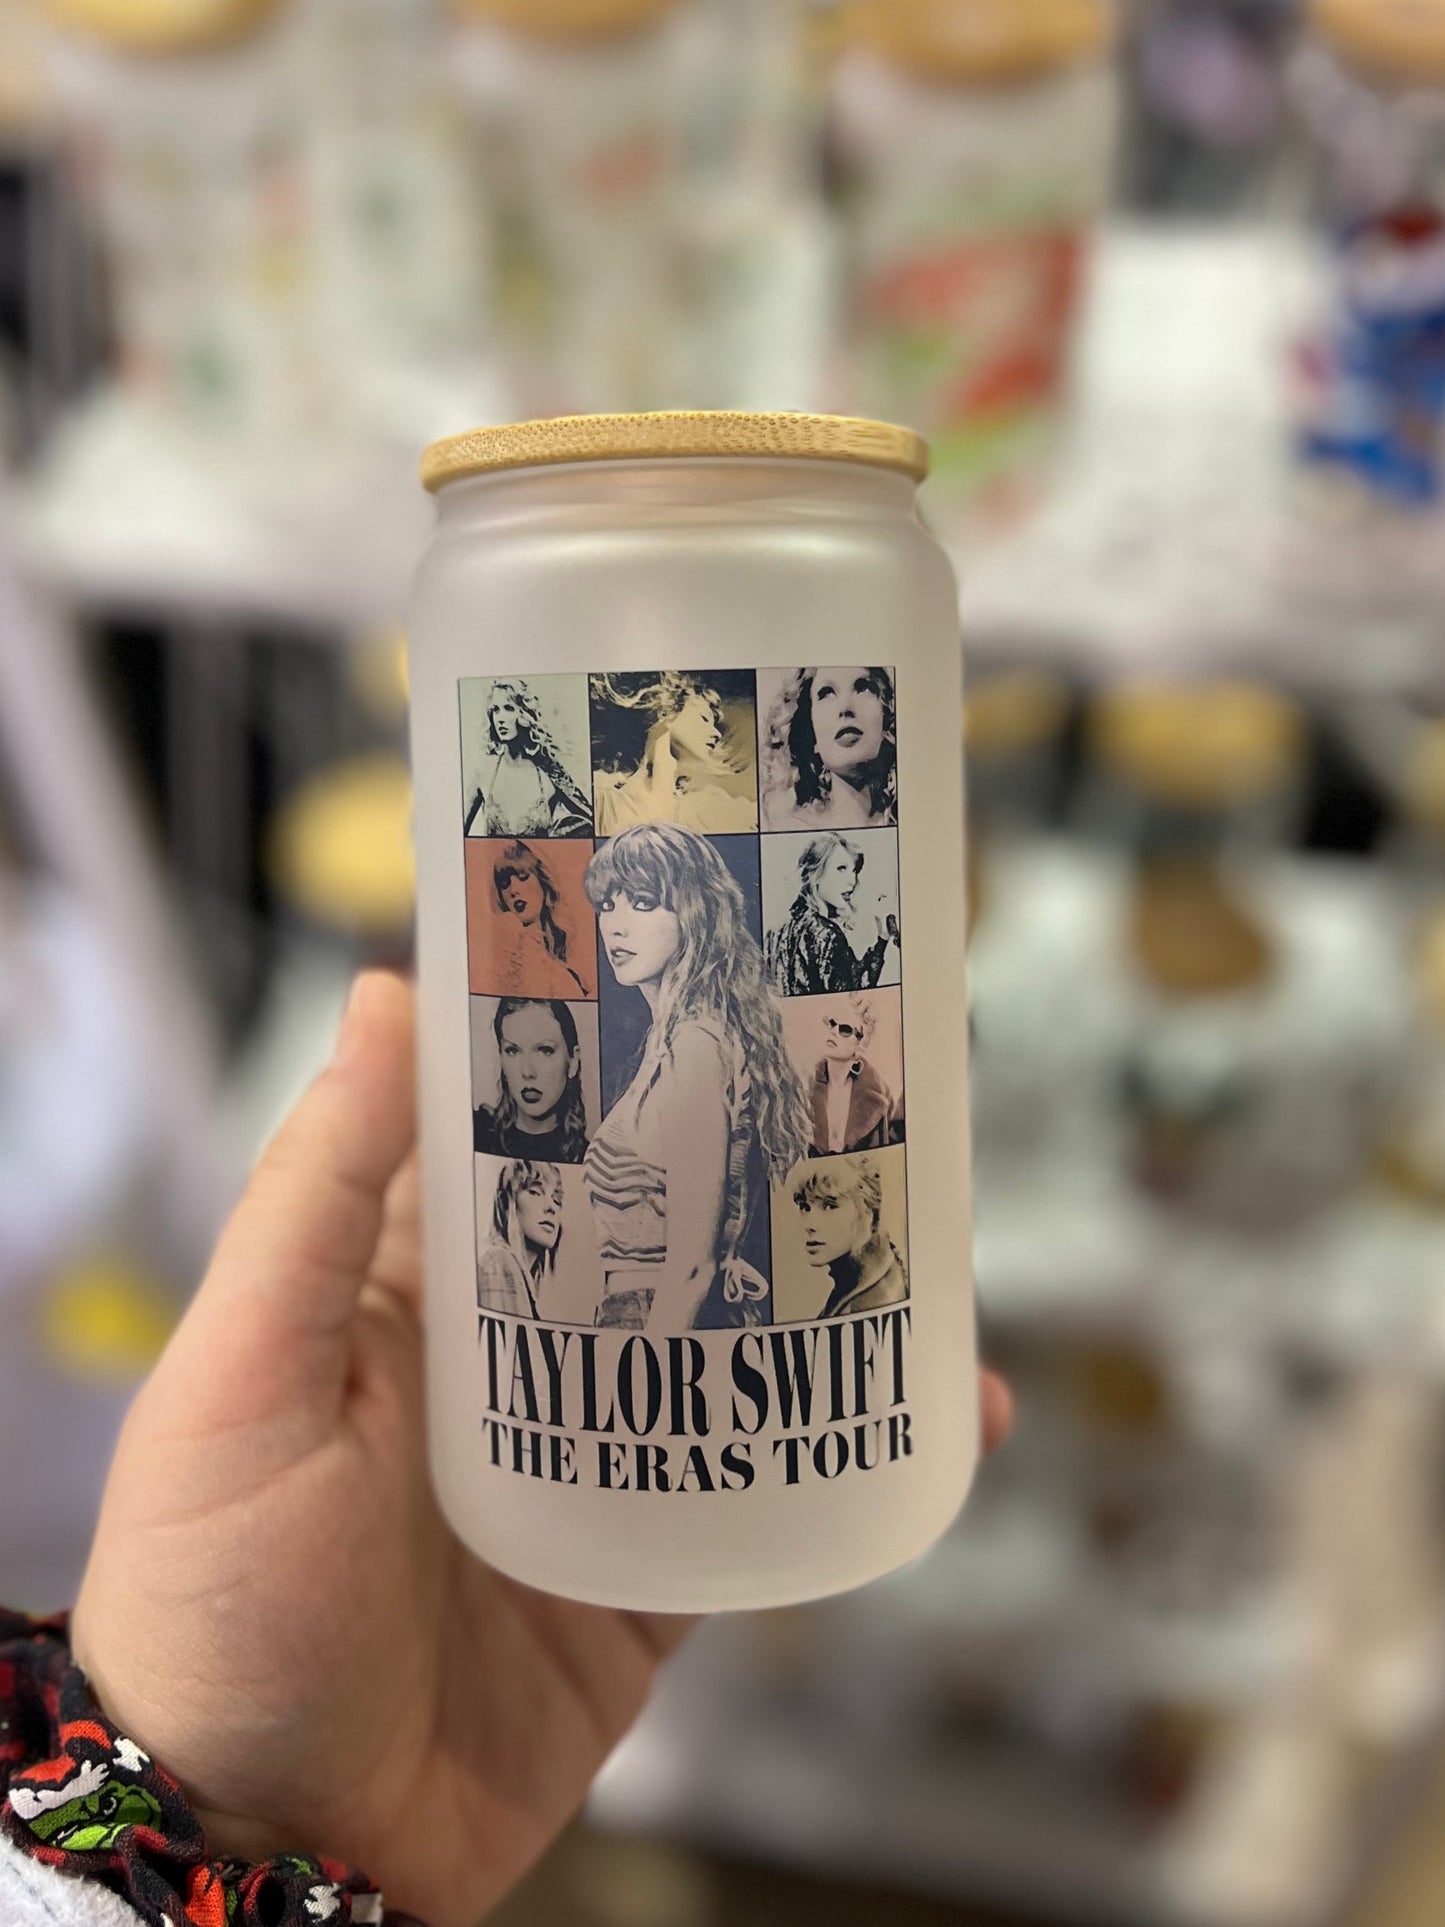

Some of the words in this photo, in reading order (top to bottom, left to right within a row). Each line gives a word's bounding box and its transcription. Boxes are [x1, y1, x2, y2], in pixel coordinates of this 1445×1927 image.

[478, 1315, 711, 1437] TAYLOR
[730, 1306, 912, 1436] SWIFT
[482, 1417, 579, 1485] THE
[596, 1441, 756, 1493] ERAS
[772, 1412, 914, 1486] TOUR
